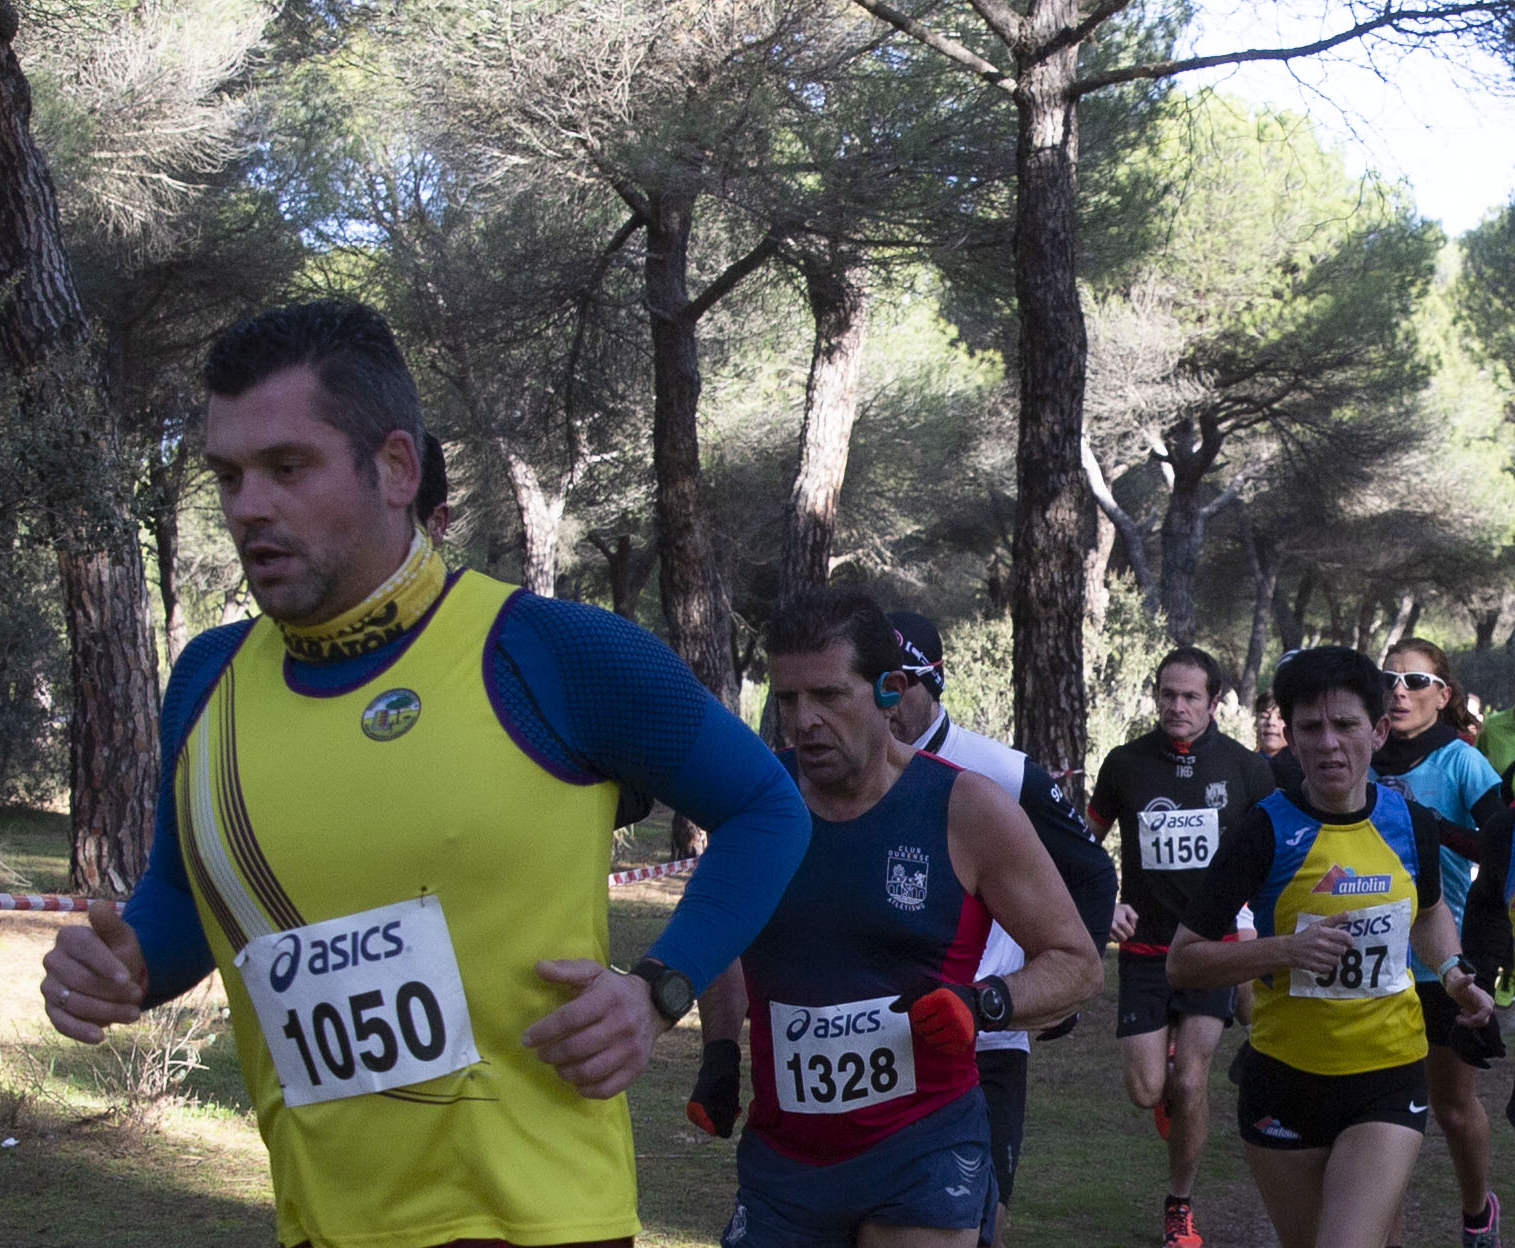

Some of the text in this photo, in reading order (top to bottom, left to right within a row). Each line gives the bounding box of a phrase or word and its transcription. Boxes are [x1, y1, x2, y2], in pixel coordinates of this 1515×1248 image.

[1167, 815, 1204, 828] asics
[898, 845, 921, 854] CLUB
[1151, 836, 1209, 864] 1156
[1339, 878, 1386, 894] antolin
[307, 920, 404, 976] asics
[282, 981, 447, 1086] 1050
[812, 1009, 882, 1039] asics
[786, 1047, 899, 1103] 1328
